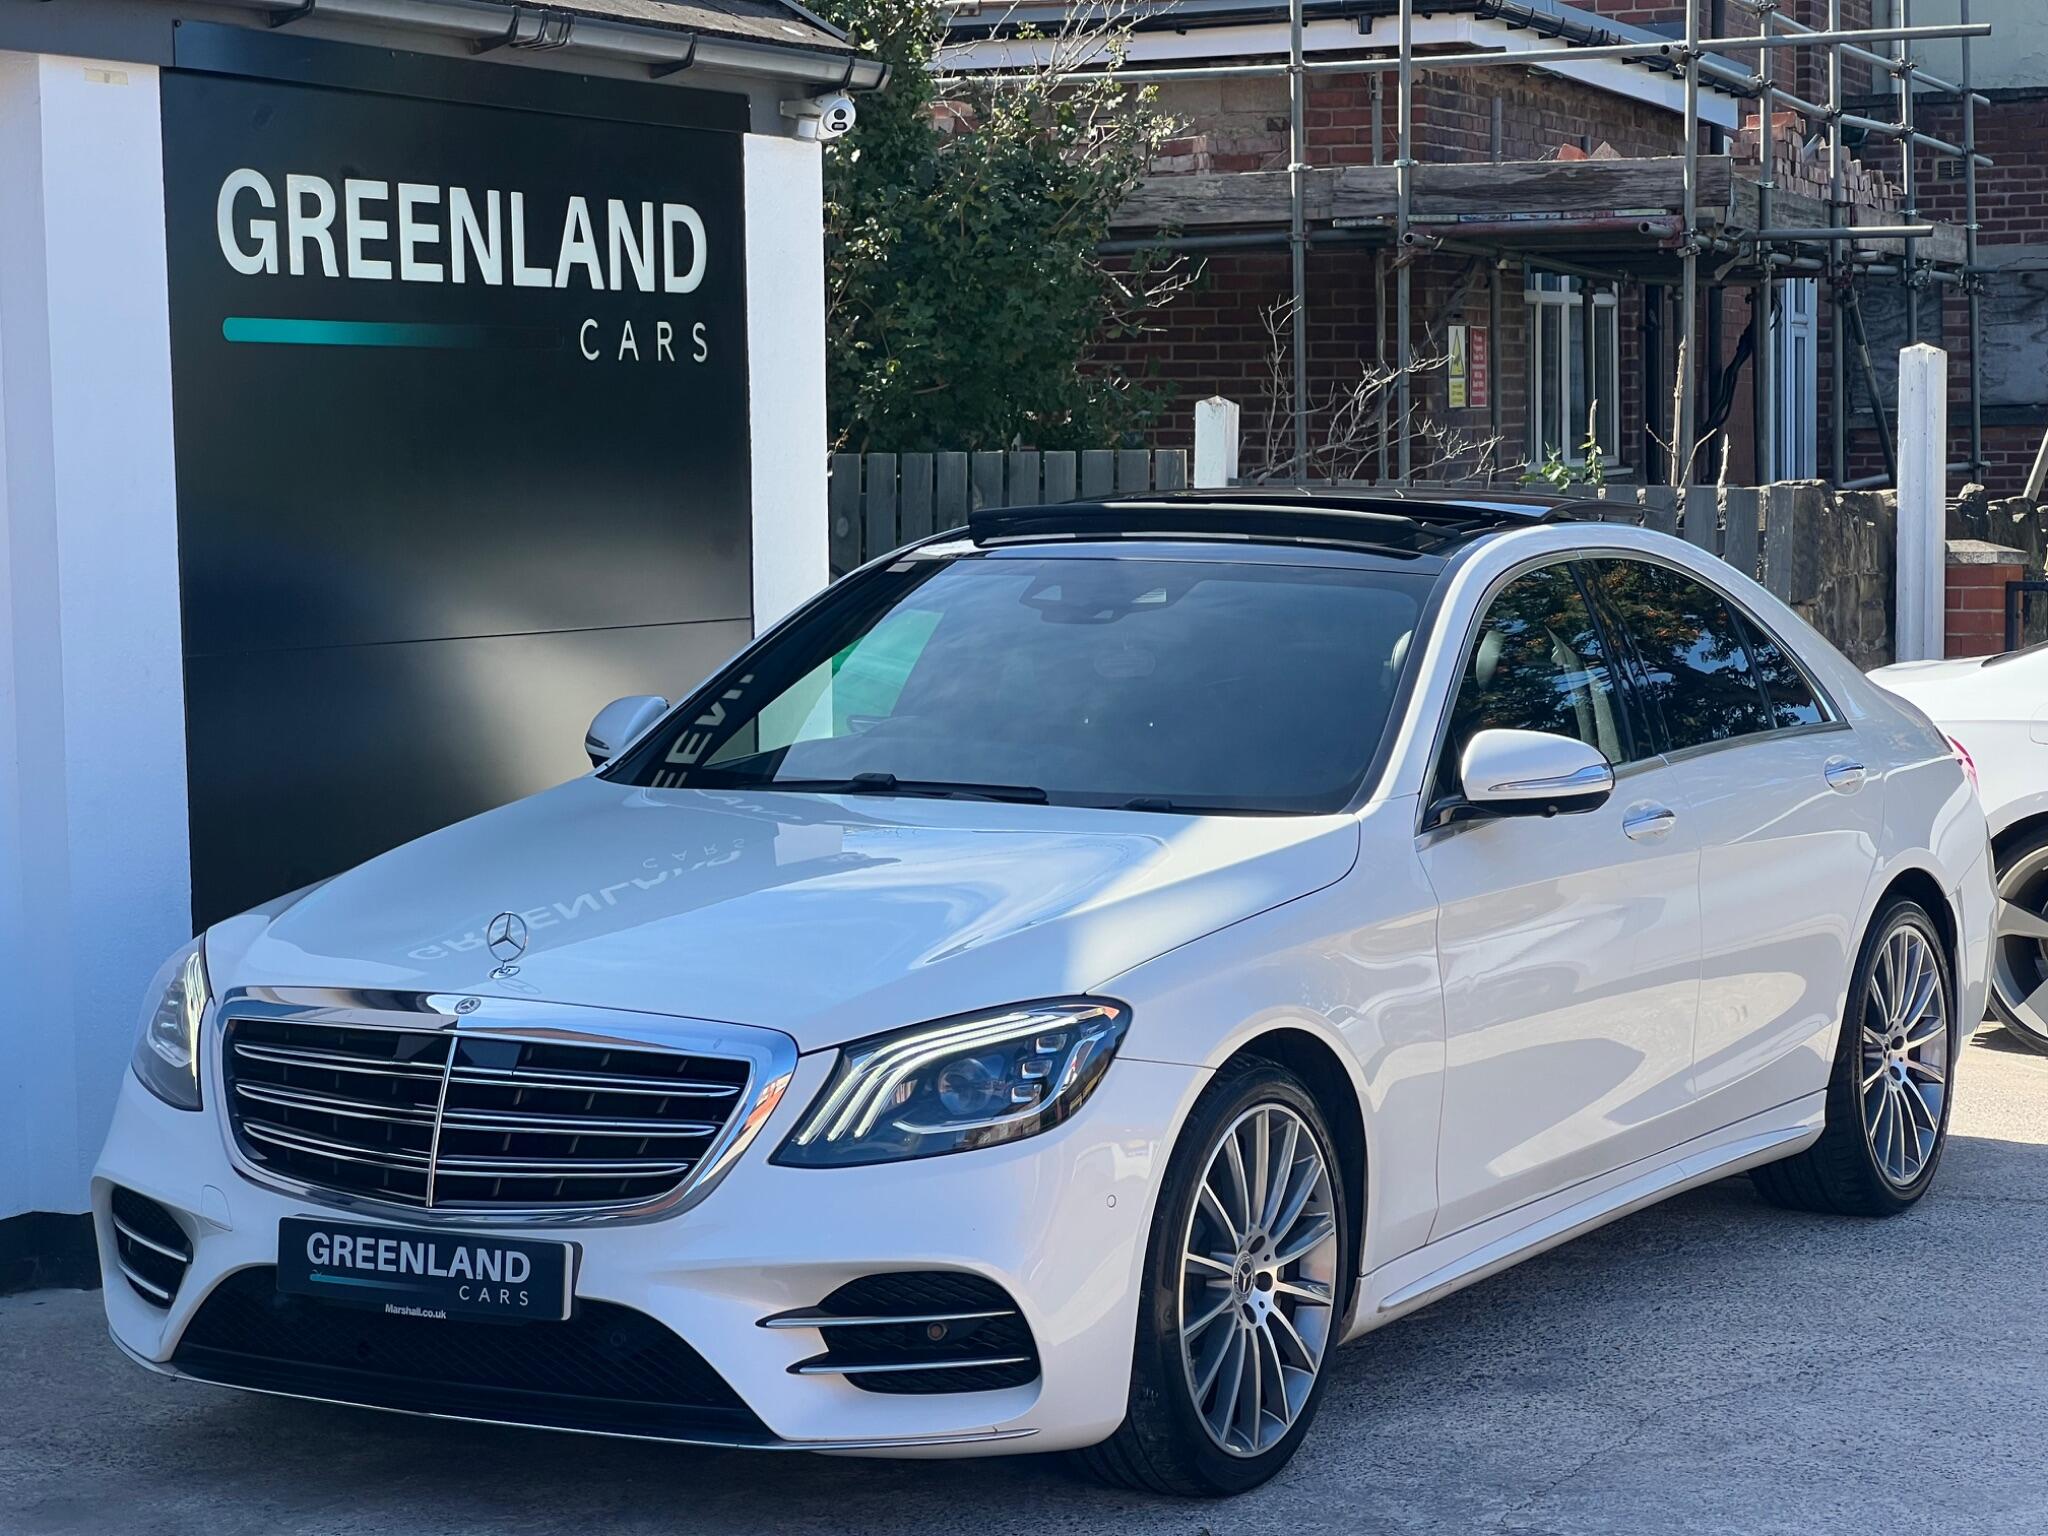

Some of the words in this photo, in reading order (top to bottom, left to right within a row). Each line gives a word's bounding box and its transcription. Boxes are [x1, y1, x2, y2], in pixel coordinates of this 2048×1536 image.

[217, 168, 708, 294] GREENLAND
[579, 318, 709, 364] CARS
[306, 1232, 531, 1284] GREENLAND
[385, 1304, 447, 1320] Marshall.co.uk
[458, 1285, 529, 1306] CARS
